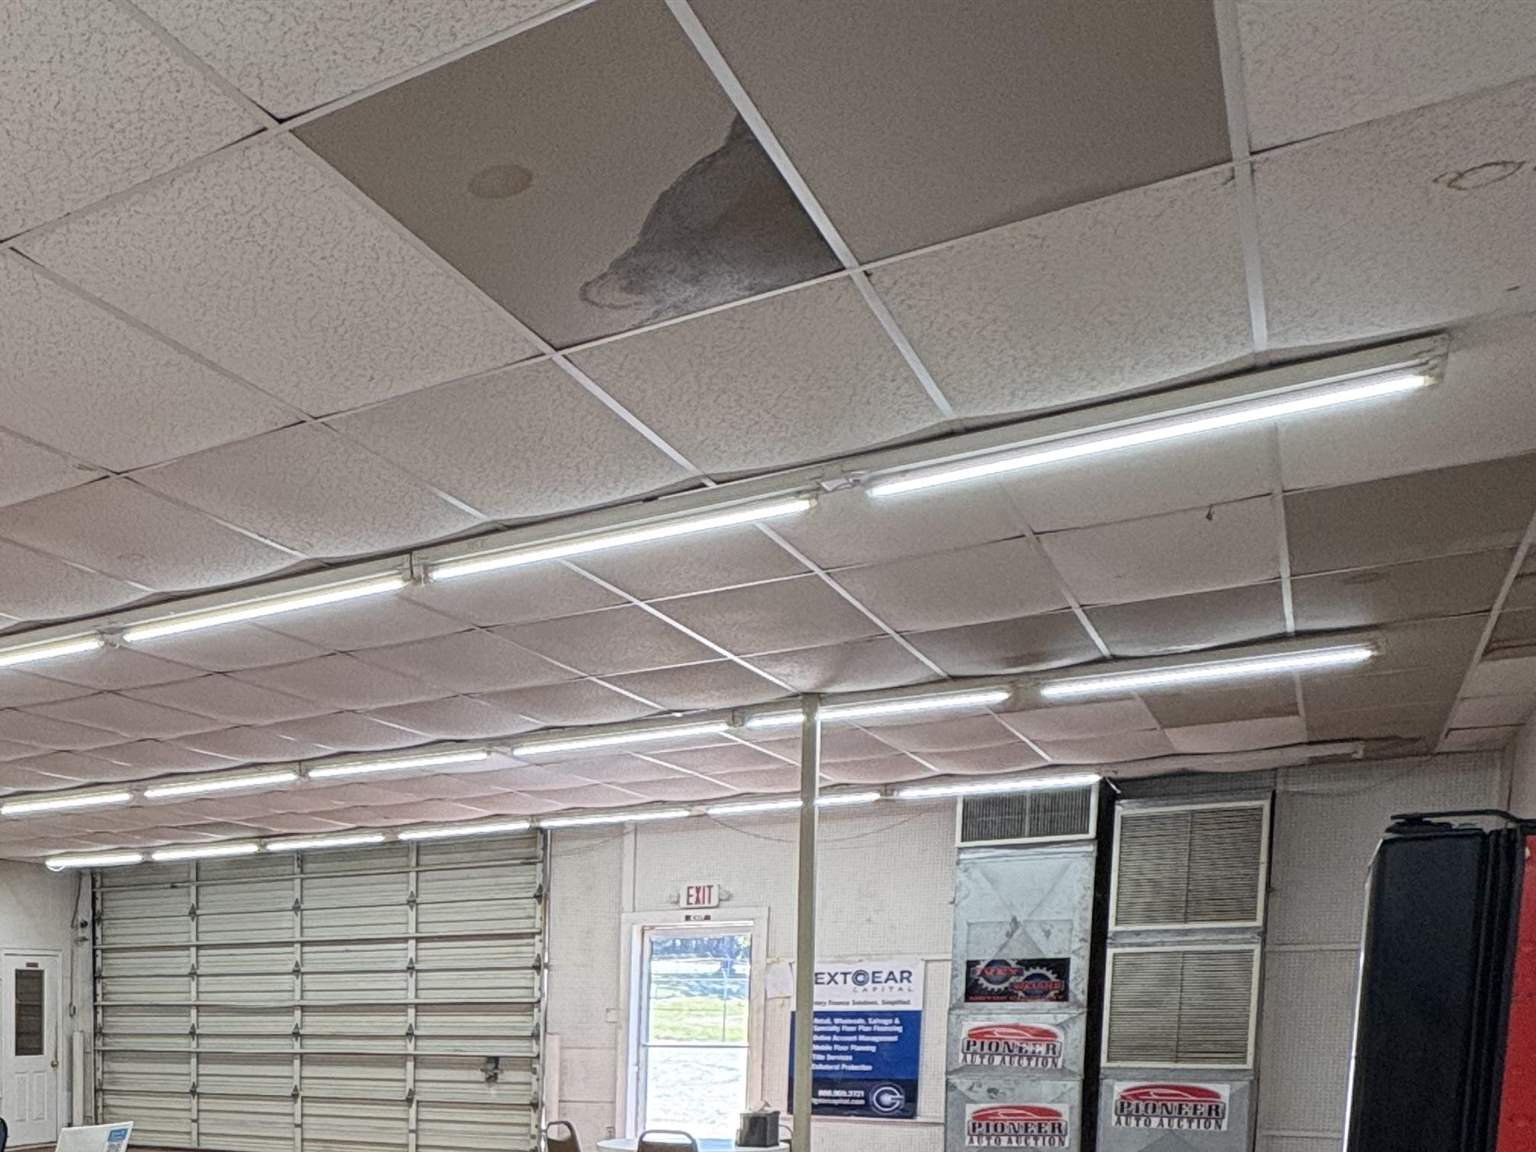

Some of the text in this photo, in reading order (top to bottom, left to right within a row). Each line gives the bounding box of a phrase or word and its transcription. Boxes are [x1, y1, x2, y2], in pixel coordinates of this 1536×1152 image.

[686, 884, 714, 905] EXIT
[966, 1040, 1057, 1055] PIONEER
[961, 1055, 1060, 1068] AUTO AUCTION
[1120, 1101, 1220, 1117] PIONEER
[971, 1122, 1063, 1134] PIONEER
[1115, 1116, 1223, 1130] AUTO AUCTION
[968, 1135, 1065, 1147] AUTO AUCTION
